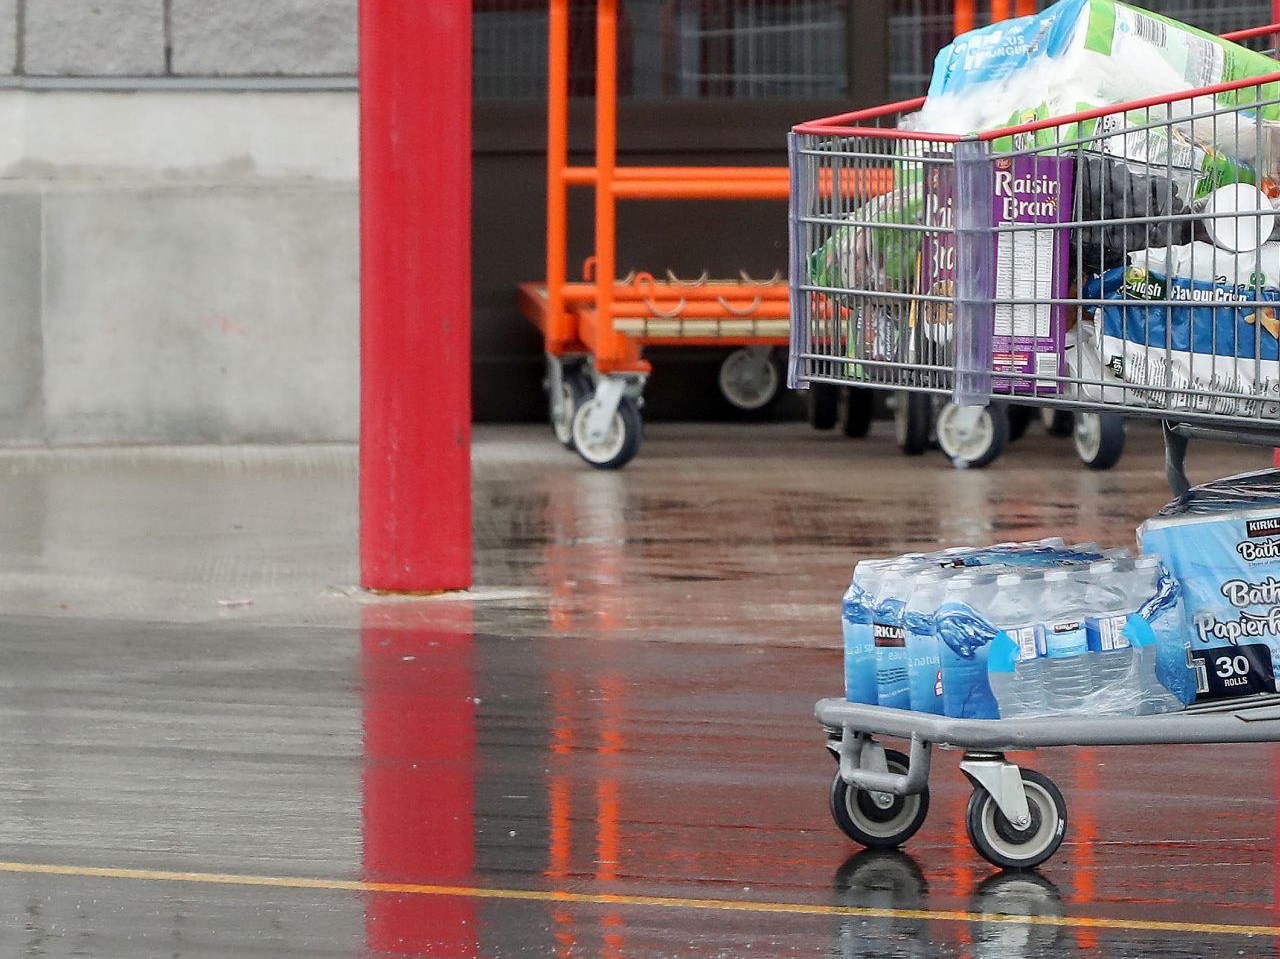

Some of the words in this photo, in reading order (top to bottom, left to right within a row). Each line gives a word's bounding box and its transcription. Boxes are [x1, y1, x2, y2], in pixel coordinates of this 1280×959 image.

[995, 170, 1061, 197] Raisin
[1002, 196, 1054, 220] Bran
[1215, 655, 1250, 678] 30
[1224, 676, 1248, 687] ROLLS
